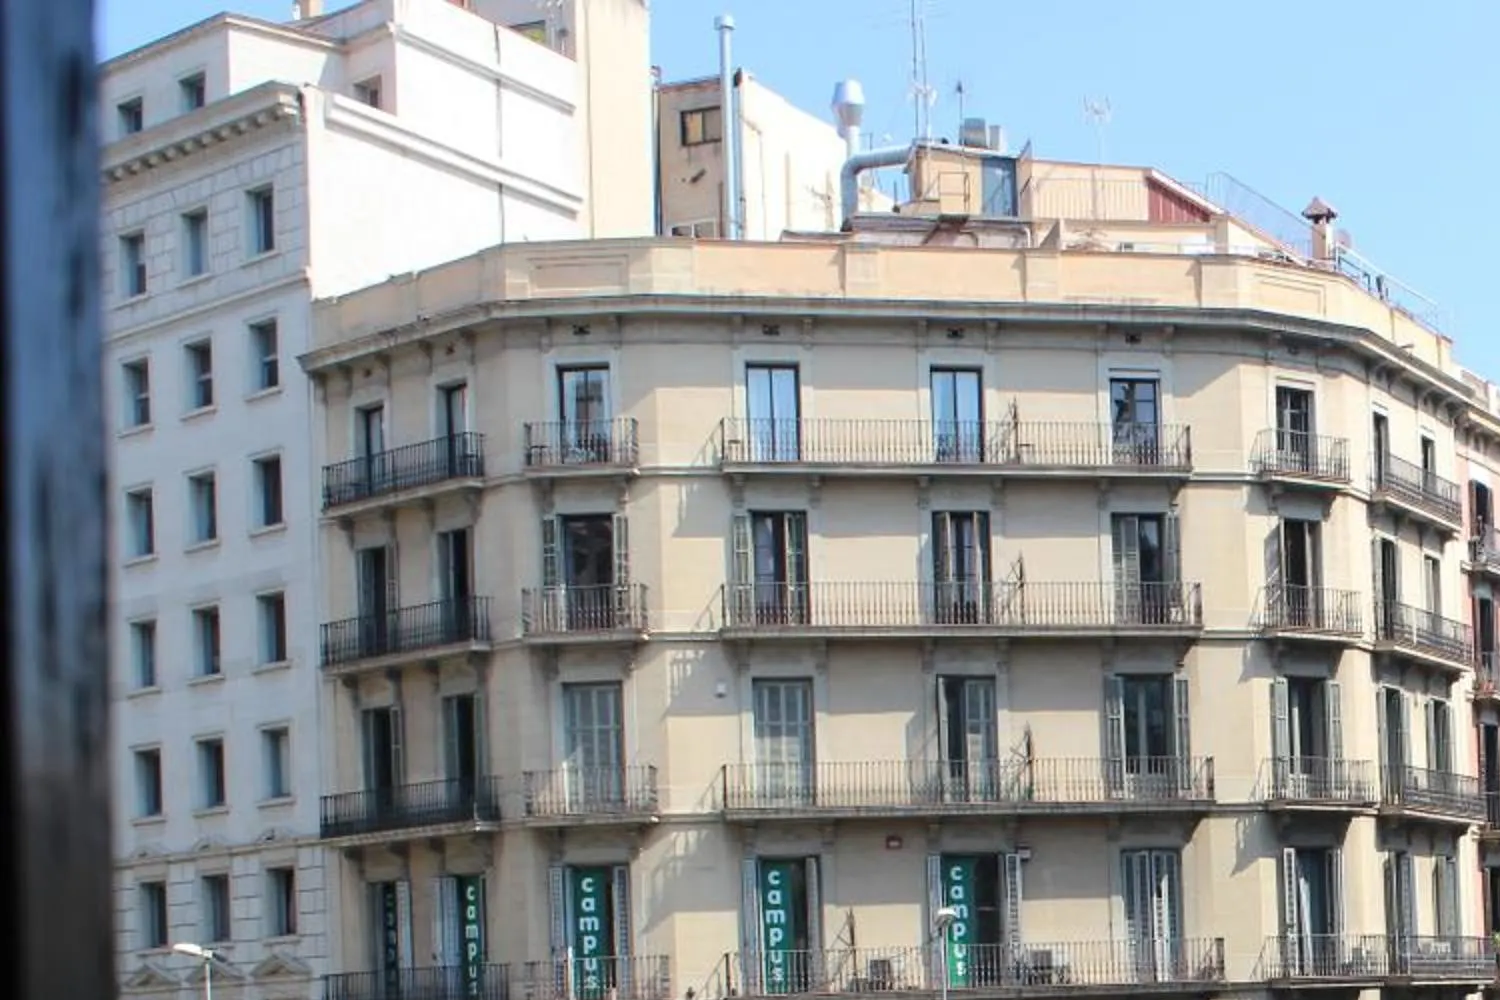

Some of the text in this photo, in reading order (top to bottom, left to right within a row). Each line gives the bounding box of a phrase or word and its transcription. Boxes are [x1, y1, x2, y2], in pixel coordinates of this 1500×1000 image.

[464, 885, 480, 996] campus
[579, 875, 600, 990] campus
[765, 870, 787, 981] campus
[949, 865, 969, 978] campus
